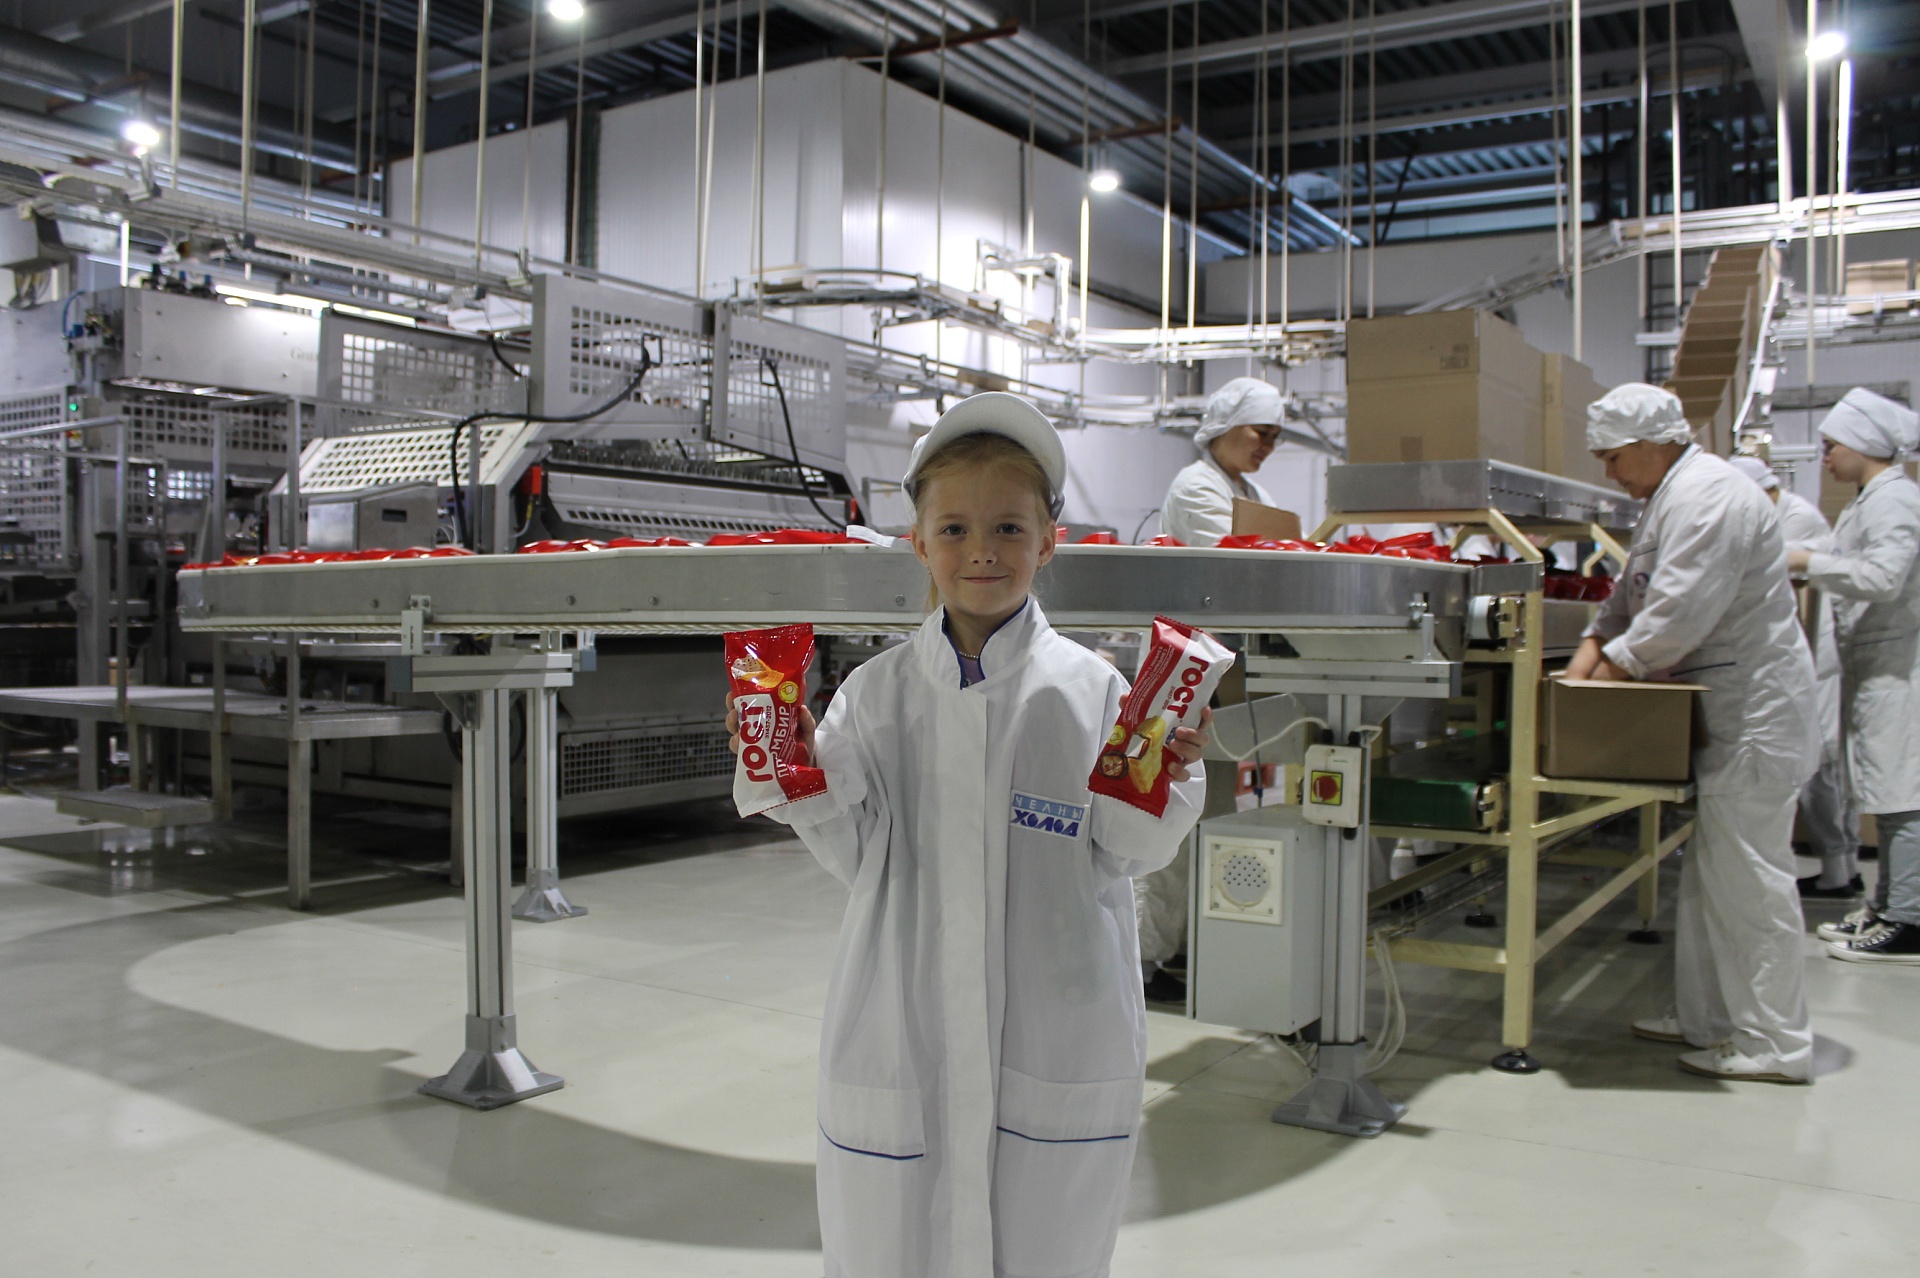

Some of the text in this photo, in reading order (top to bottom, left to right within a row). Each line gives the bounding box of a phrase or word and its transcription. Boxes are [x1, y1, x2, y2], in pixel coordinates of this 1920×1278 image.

[1167, 655, 1209, 719] ГОСТ
[740, 701, 774, 783] ГОСТ
[1010, 808, 1080, 837] ХОЛОД
[1014, 794, 1083, 819] ЧЕЛНЫ
